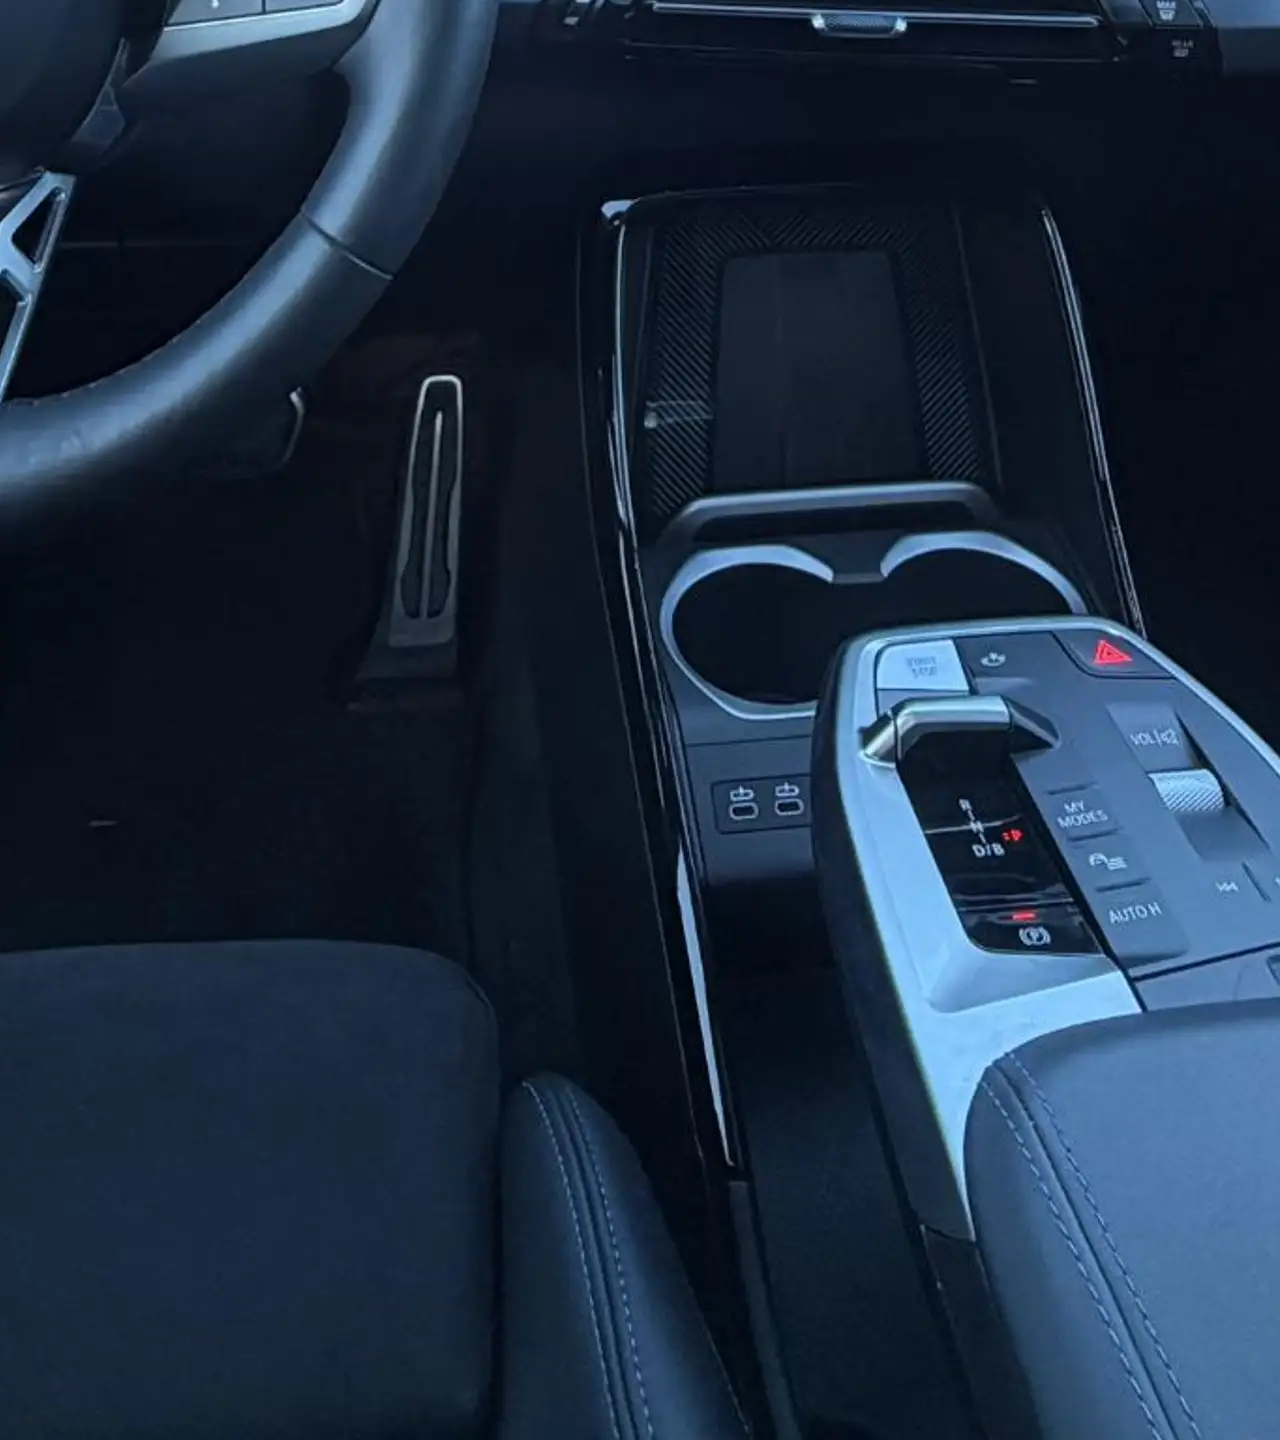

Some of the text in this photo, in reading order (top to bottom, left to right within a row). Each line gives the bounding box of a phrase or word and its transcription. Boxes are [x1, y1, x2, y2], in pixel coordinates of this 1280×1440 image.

[1064, 800, 1085, 813] MY
[1057, 810, 1109, 829] MODES
[1108, 902, 1163, 925] AUTO H
